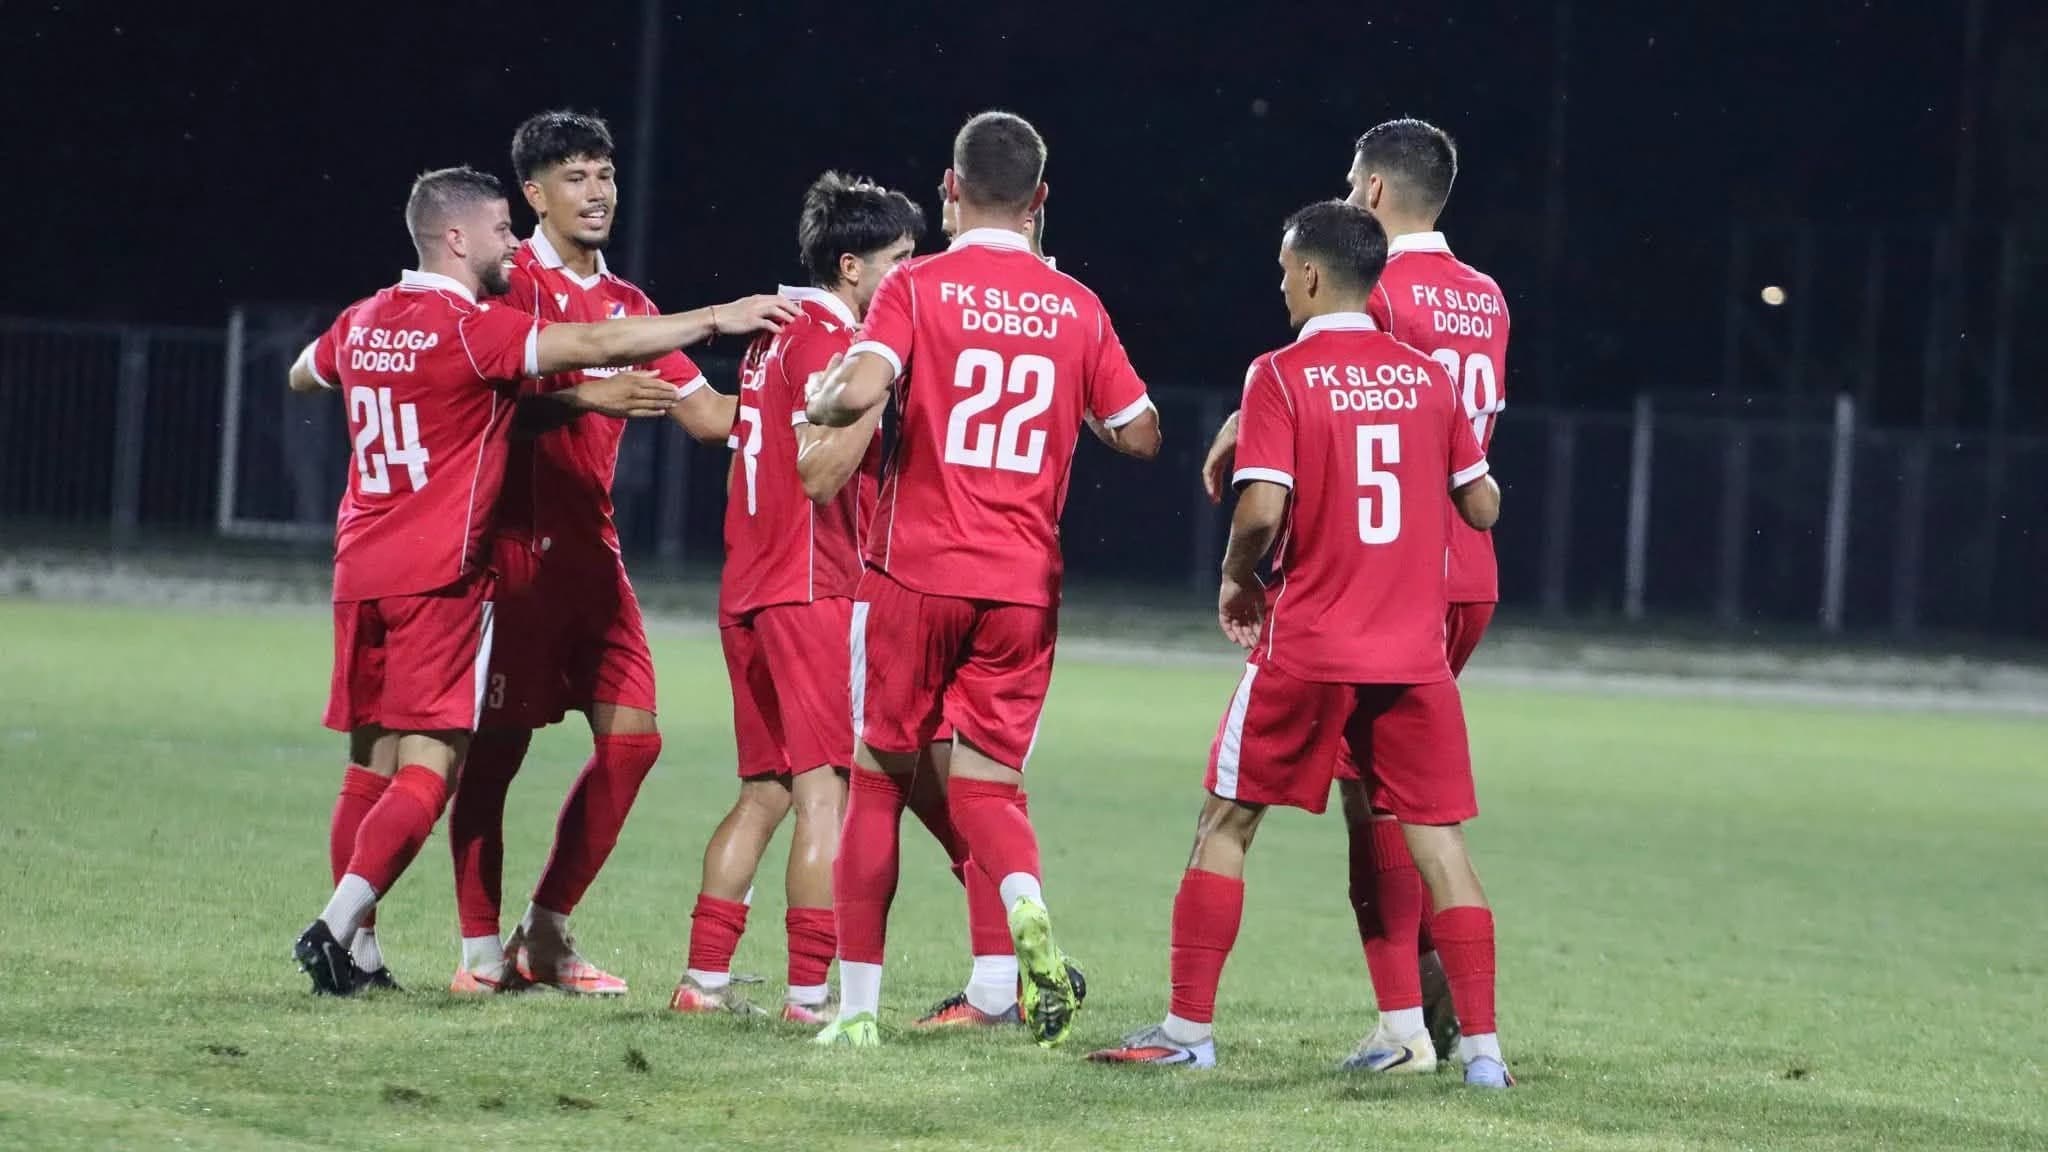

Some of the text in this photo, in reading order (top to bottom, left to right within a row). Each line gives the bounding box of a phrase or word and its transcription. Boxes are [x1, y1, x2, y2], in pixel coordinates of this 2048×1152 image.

[940, 282, 1078, 319] FK SLOGA
[1411, 284, 1502, 316] FK SLOGA
[369, 328, 439, 351] SLOGA
[961, 308, 1058, 340] DOBOJ
[1432, 310, 1493, 340] DOBOJ
[351, 349, 416, 373] DOBOJ
[1303, 364, 1432, 389] FK SLOGA
[944, 348, 1056, 475] 22
[1330, 388, 1419, 412] DOBOJ
[350, 385, 430, 494] 24
[1356, 424, 1401, 545] 5
